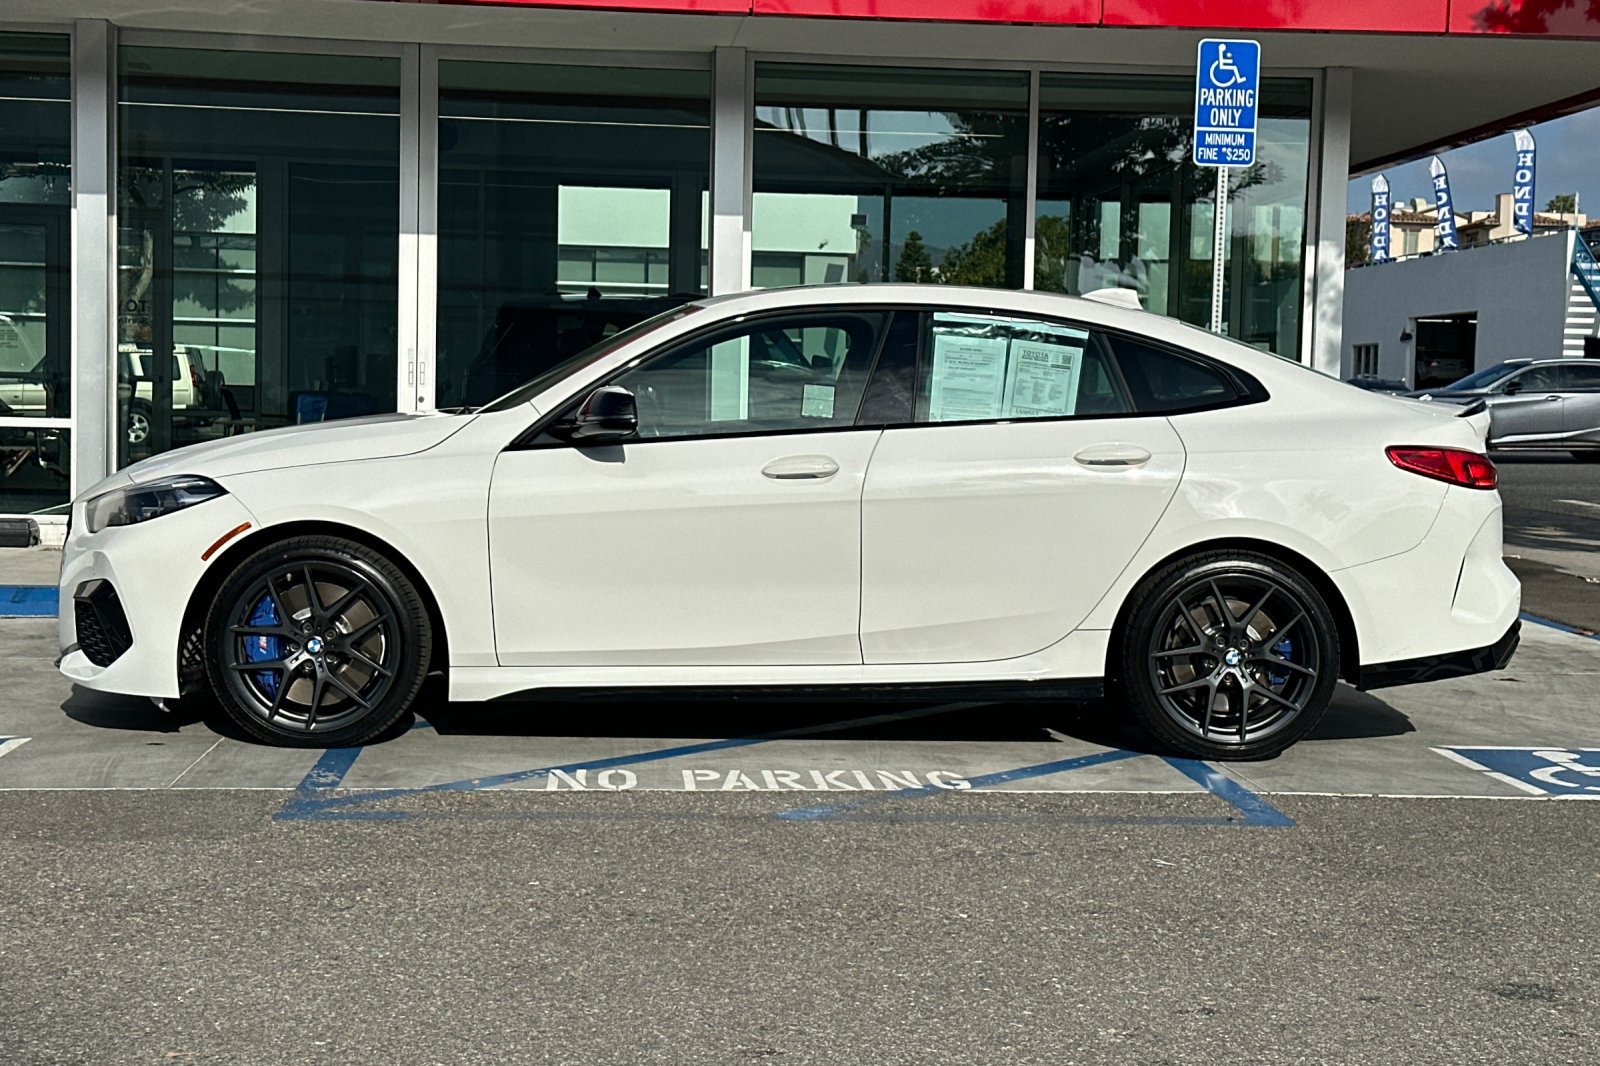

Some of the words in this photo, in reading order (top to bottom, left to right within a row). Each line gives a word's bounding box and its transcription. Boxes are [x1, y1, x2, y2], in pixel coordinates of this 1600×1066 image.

[1200, 88, 1254, 107] PARKING
[1210, 108, 1242, 126] ONLY
[1205, 133, 1245, 146] MINIMUM
[1198, 148, 1218, 160] FINE
[1226, 148, 1251, 161] $250
[1023, 350, 1049, 358] TOYOTA
[546, 769, 638, 791] NO
[682, 769, 972, 791] PARKING
